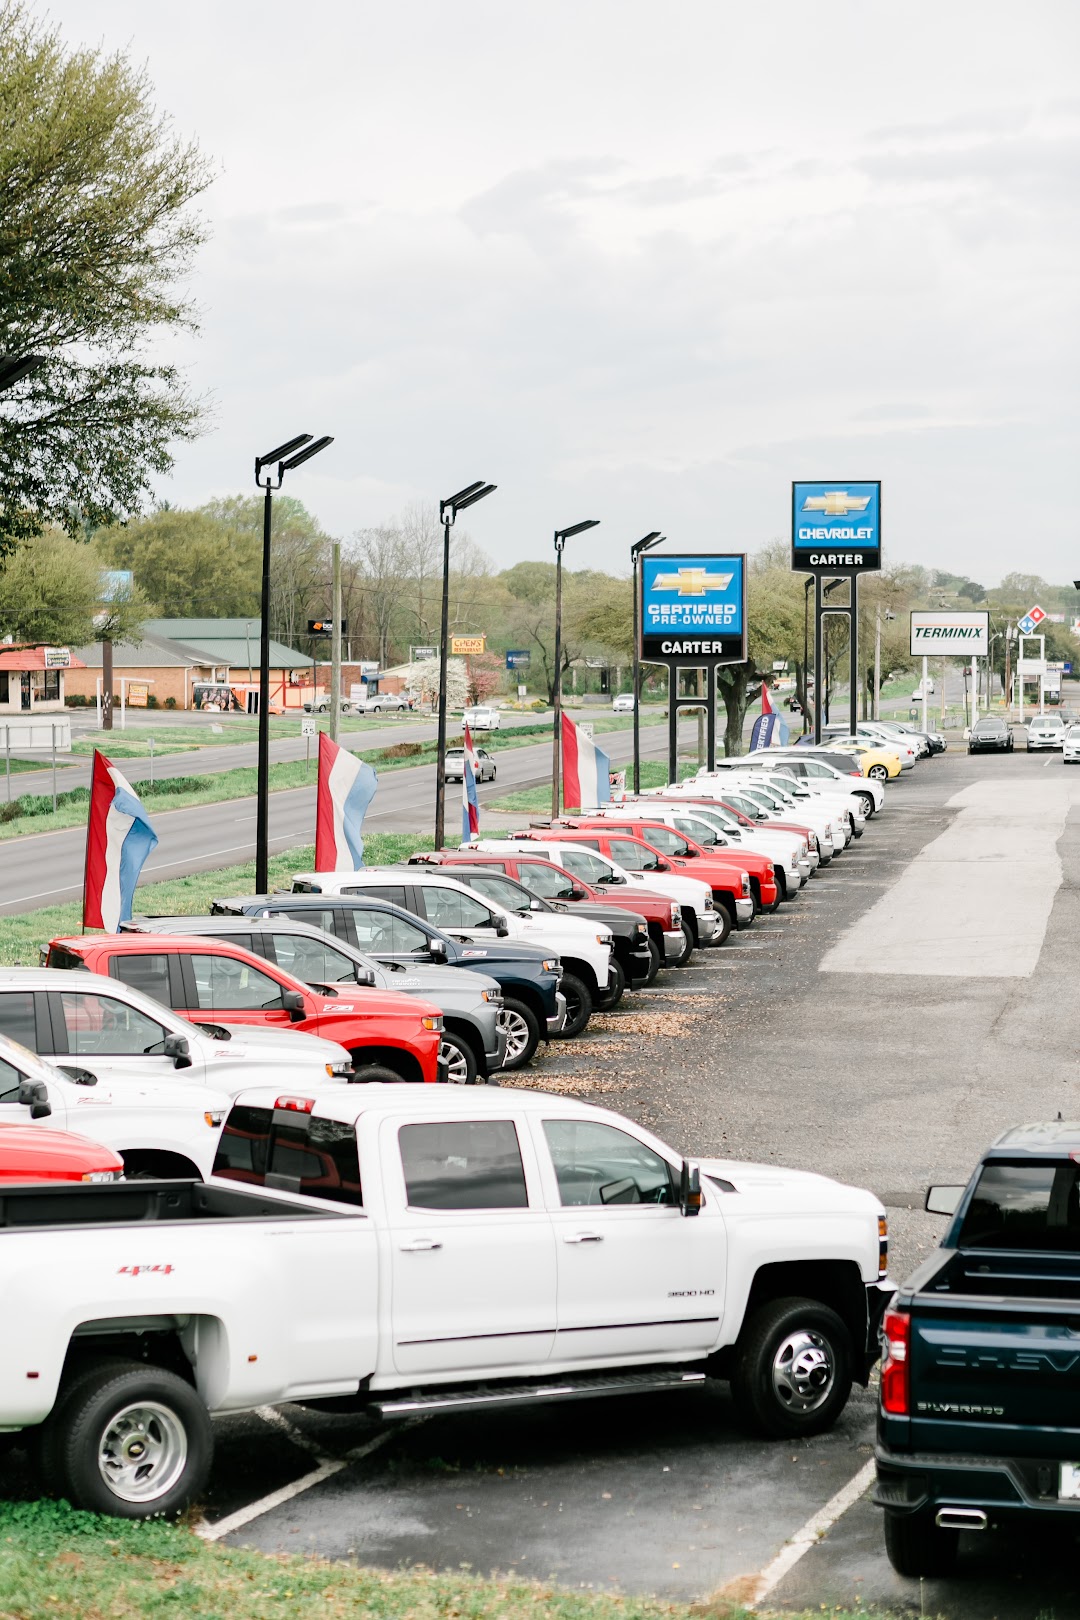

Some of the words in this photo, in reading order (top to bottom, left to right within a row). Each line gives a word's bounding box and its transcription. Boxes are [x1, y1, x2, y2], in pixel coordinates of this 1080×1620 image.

[798, 527, 874, 540] CHEVROLET
[809, 554, 863, 565] CARTER
[647, 604, 737, 615] CERTIFIED
[652, 615, 732, 625] PRE-OWNED
[915, 627, 983, 638] TERMINIX
[661, 641, 722, 654] CARTER
[756, 716, 769, 751] ERTIFIED
[917, 1402, 1004, 1416] SILVERADO
